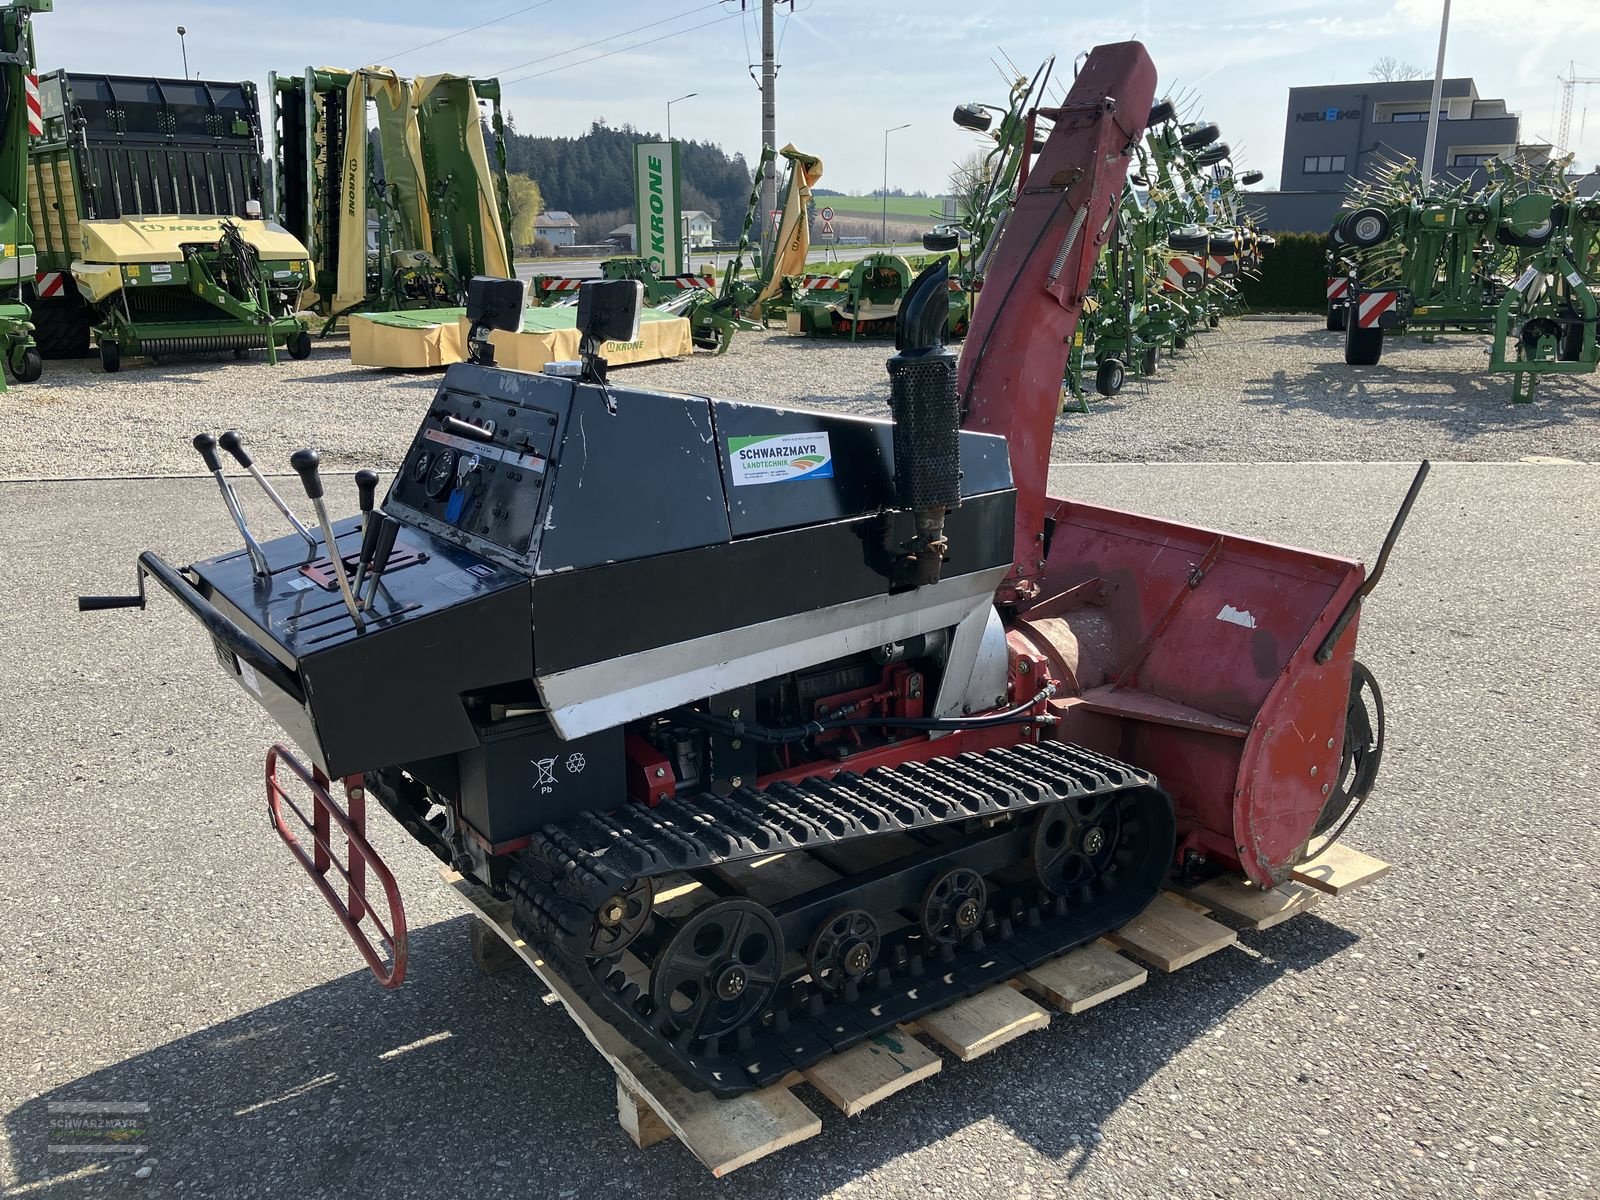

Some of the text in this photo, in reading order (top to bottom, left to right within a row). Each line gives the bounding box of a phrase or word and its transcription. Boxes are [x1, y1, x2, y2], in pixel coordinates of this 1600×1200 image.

[348, 172, 356, 217] KRONE
[648, 155, 665, 254] KRONE
[616, 341, 644, 352] KRONE
[739, 444, 817, 460] SCHWARZMAYR
[743, 459, 789, 470] LANDTECHNIK
[541, 786, 553, 795] Pb
